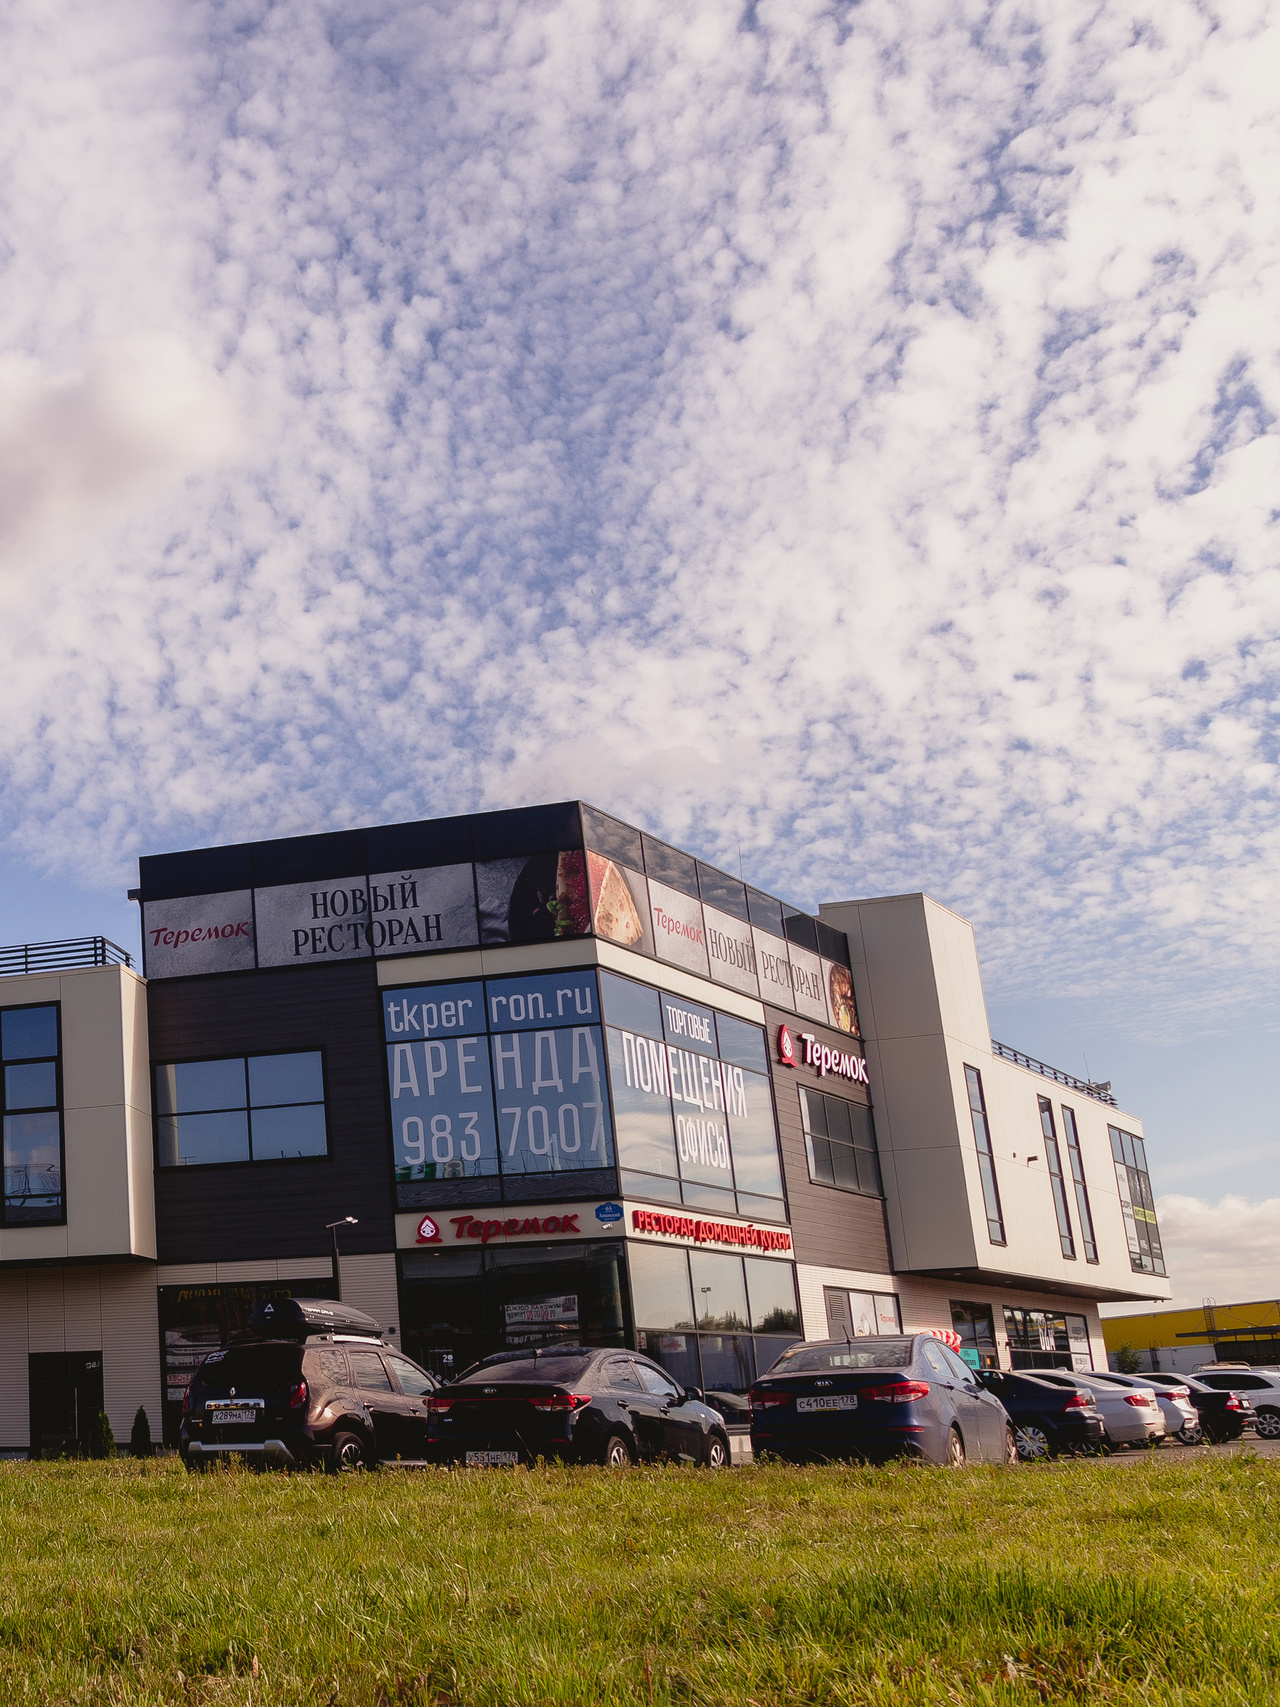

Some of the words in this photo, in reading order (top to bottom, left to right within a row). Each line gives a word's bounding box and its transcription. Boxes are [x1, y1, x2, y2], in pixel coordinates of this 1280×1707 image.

[310, 874, 420, 920] НОВЫЙ
[149, 921, 250, 949] Теремок
[292, 913, 444, 957] РЕСТОРАН
[654, 907, 704, 946] Теремок
[708, 927, 758, 976] НОВЫЙ
[761, 950, 822, 1002] РЕСТОРАН
[665, 1005, 712, 1044] ТОРГОВЫЕ
[392, 1026, 601, 1099] АРЕНДА
[622, 1030, 748, 1119] ПОМЕЩЕНИЯ
[799, 1032, 870, 1085] Теремок
[401, 1111, 482, 1165] 983
[501, 1101, 604, 1158] 7007
[676, 1114, 731, 1170] ОФИСЫ
[449, 1213, 582, 1244] Теремок
[633, 1209, 696, 1238] РЕСТОРАН
[696, 1219, 759, 1245] ДОМАШНЕЙ
[759, 1226, 793, 1251] КУХНИ
[215, 1411, 242, 1420] Х289МА
[243, 1410, 255, 1418] 178
[799, 1397, 838, 1409] С410ЕЕ
[840, 1395, 855, 1404] 178
